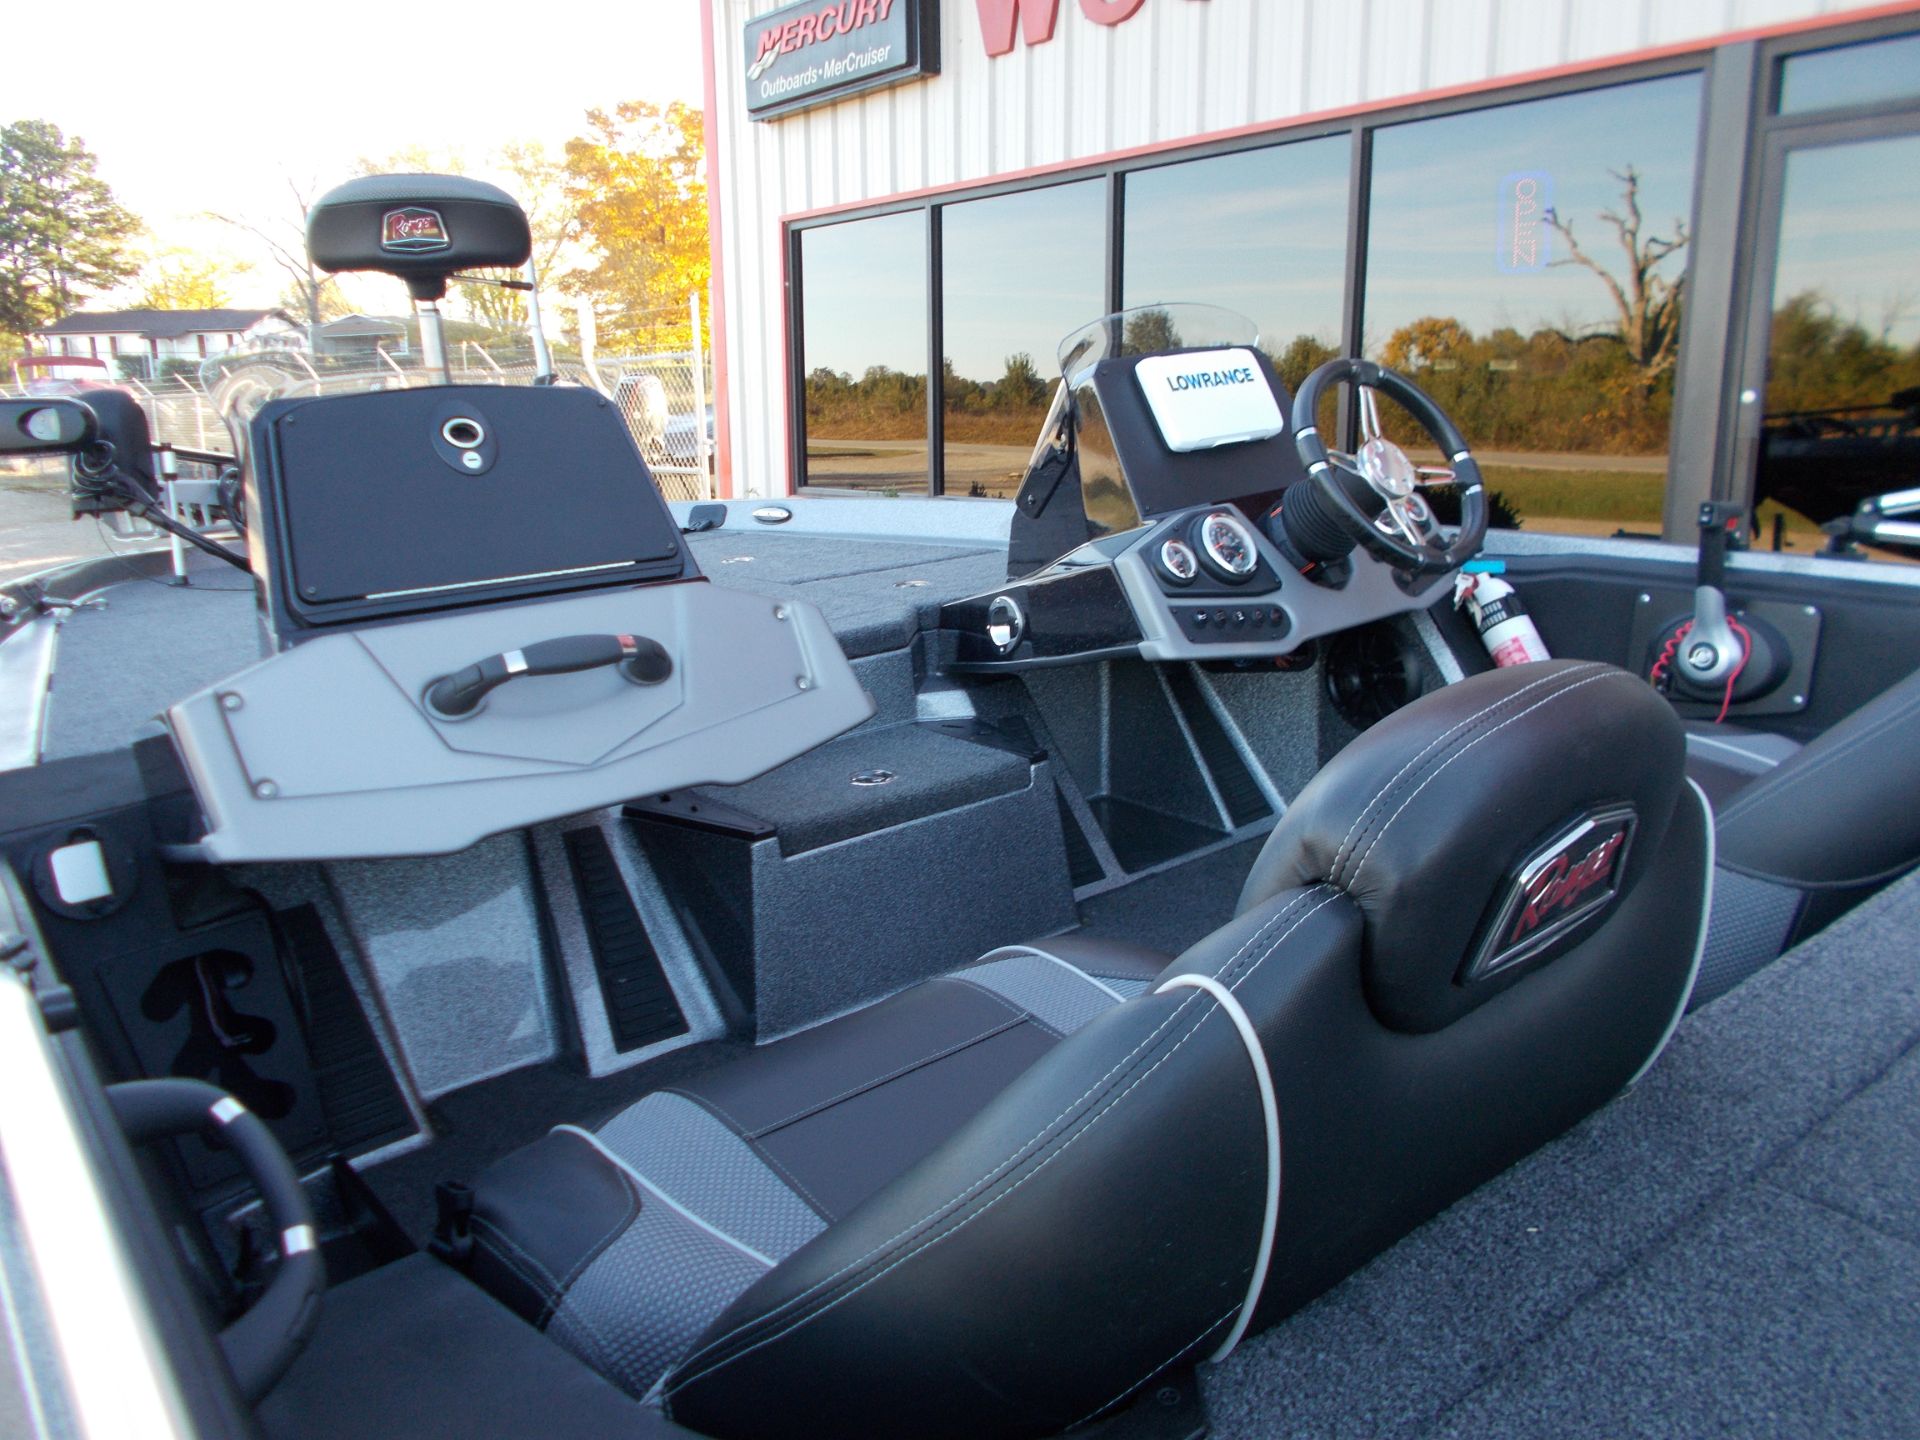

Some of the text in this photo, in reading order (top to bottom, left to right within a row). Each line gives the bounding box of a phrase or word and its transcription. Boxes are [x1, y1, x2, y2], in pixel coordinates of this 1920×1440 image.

[755, 0, 894, 62] MERCURY
[761, 44, 892, 98] Outboards MerCruiser
[1512, 177, 1537, 268] OPEN
[1166, 367, 1255, 392] LOWRANCE
